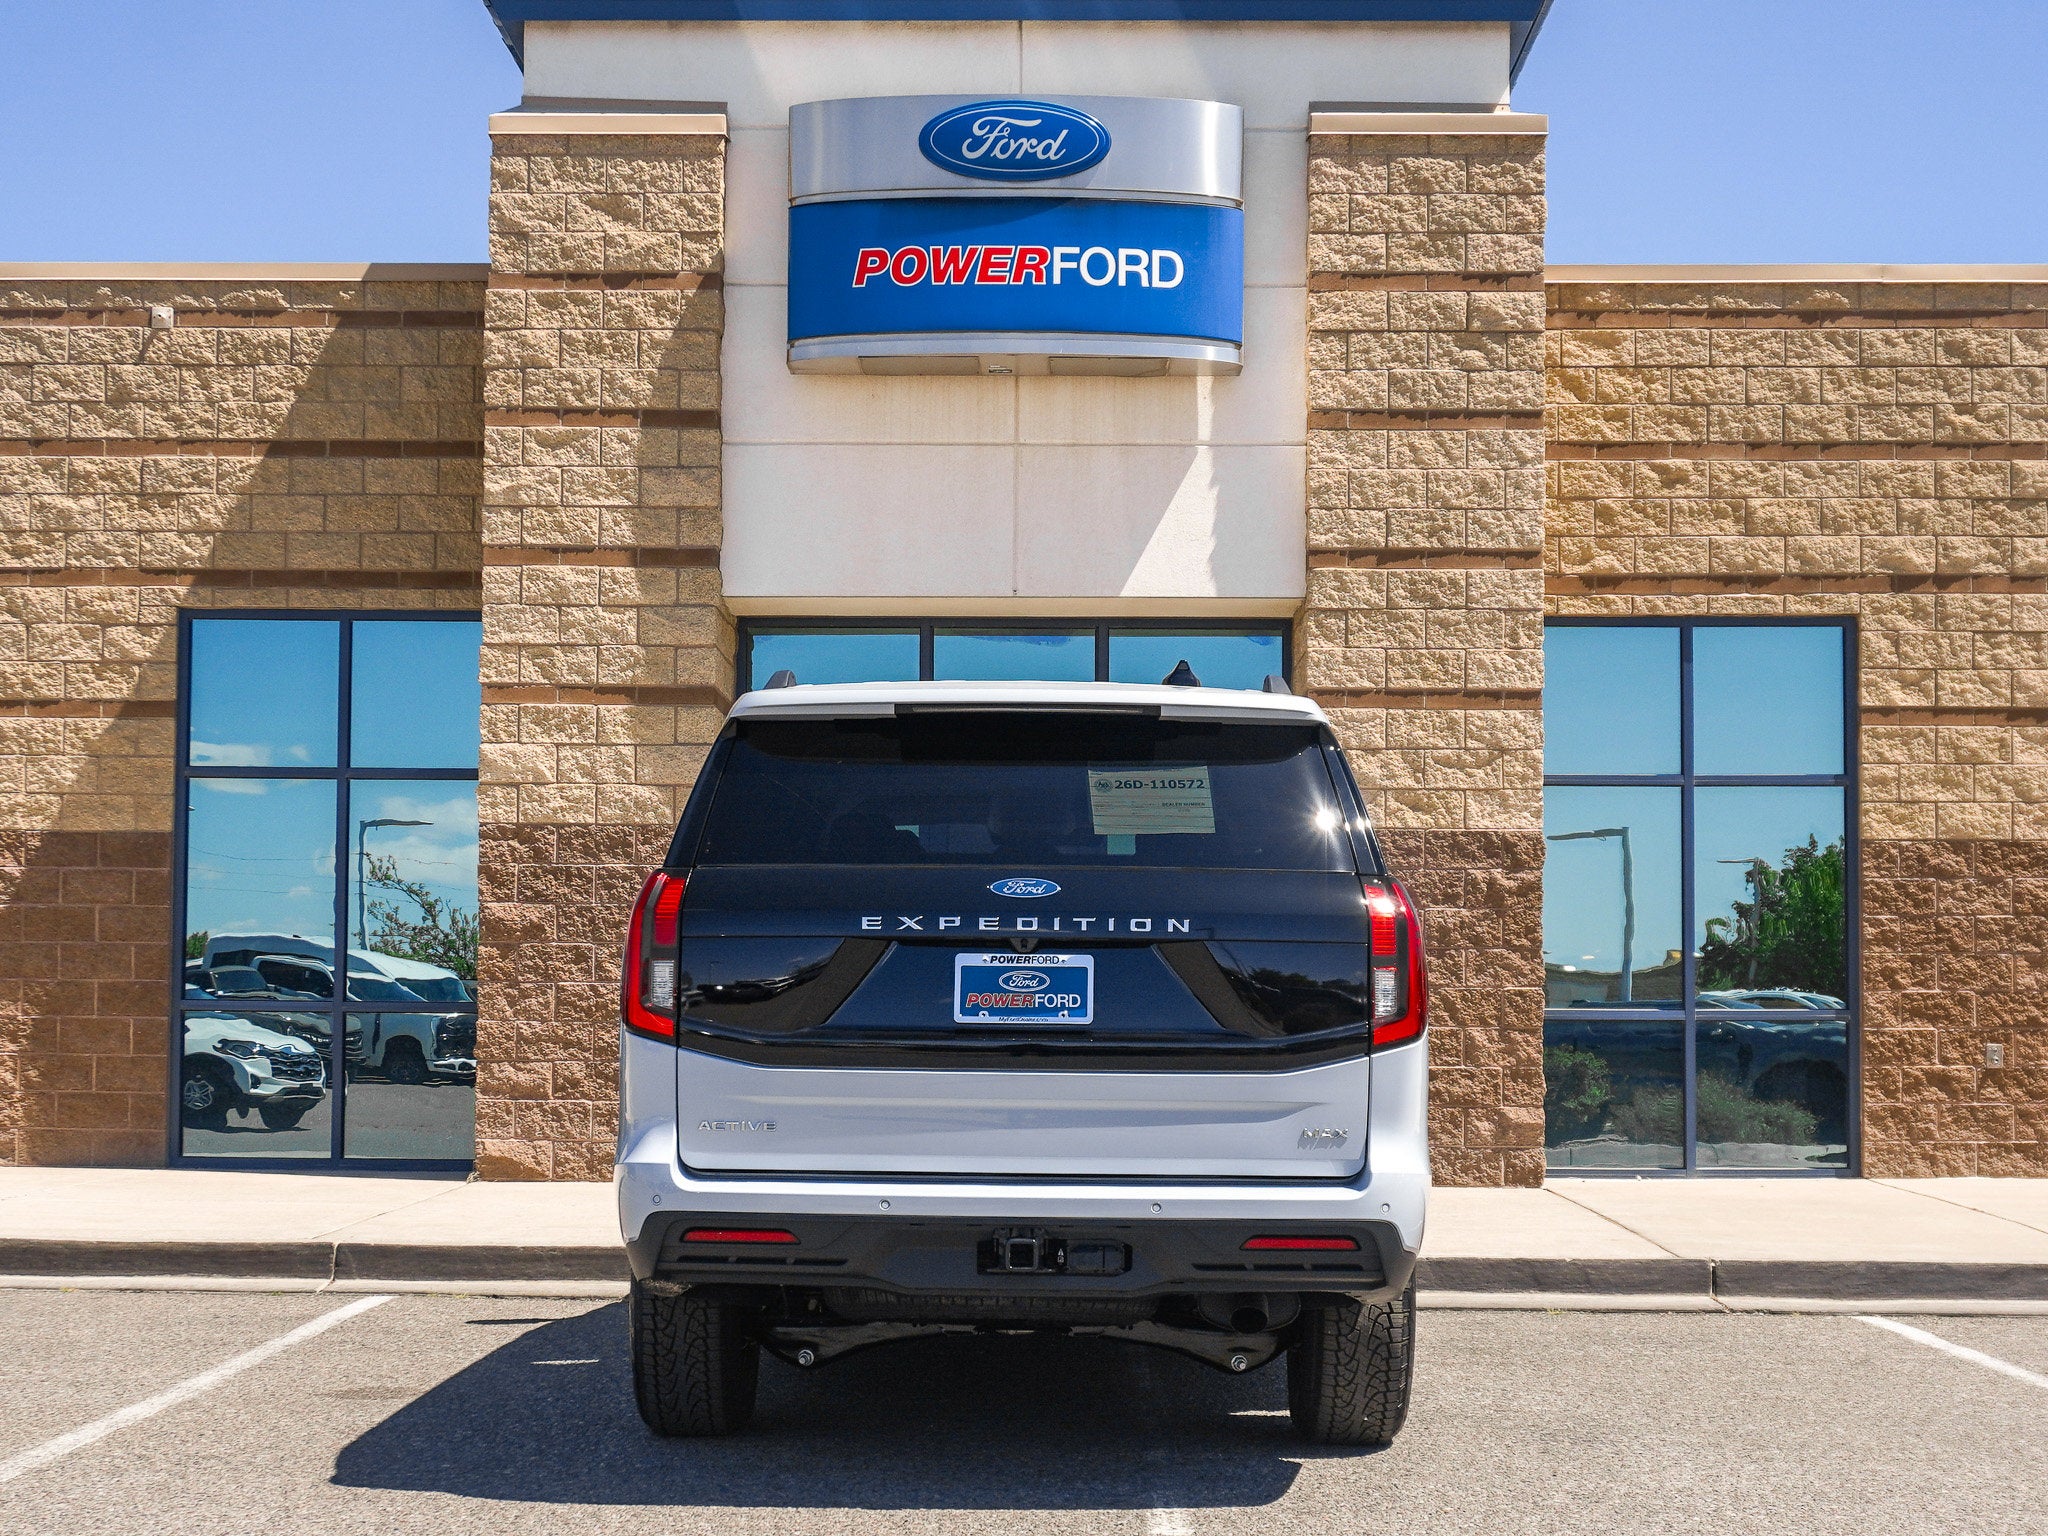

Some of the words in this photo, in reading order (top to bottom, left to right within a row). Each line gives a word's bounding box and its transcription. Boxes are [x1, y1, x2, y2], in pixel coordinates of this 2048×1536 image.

[962, 116, 1066, 160] Ford
[852, 245, 1185, 289] POWERFORD
[1114, 779, 1206, 789] 26D-110572
[1002, 879, 1046, 895] Ford
[861, 915, 1191, 933] EXPEDITION
[989, 955, 1060, 964] POWERFORD
[1009, 974, 1040, 988] Ford
[966, 993, 1081, 1008] POWERFORD
[698, 1120, 777, 1132] ACTIVE
